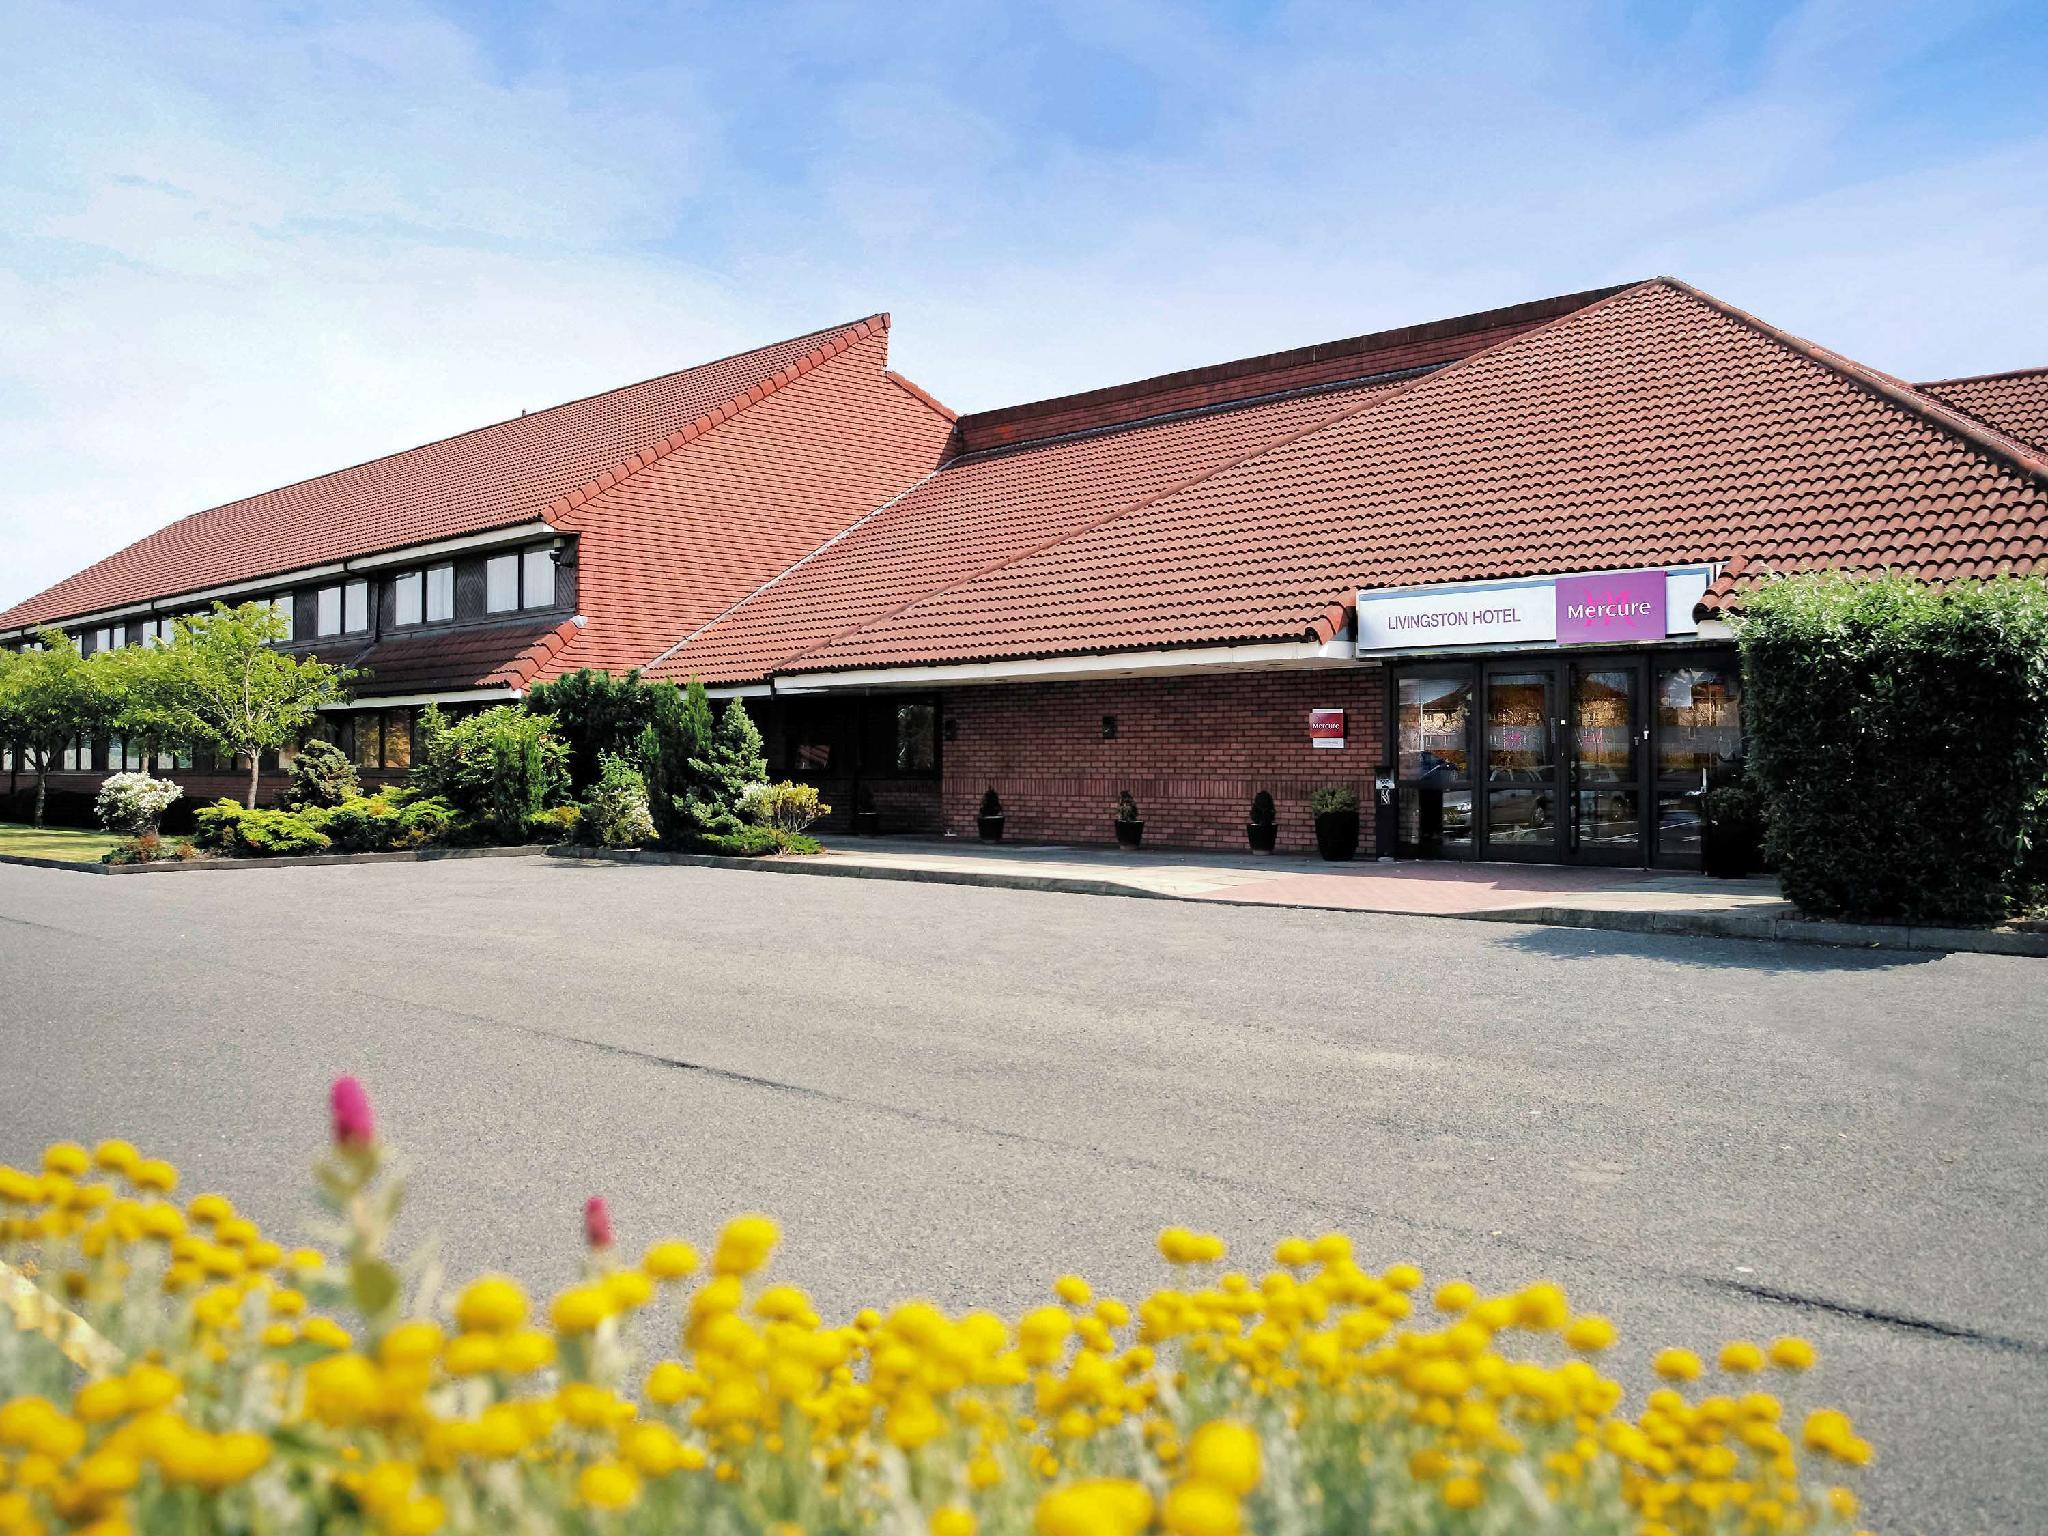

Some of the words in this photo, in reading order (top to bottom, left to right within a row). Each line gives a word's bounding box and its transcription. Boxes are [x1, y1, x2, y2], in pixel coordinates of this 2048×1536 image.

[1388, 611, 1468, 630] LIVINGSTON
[1472, 608, 1521, 625] HOTEL
[1567, 602, 1652, 619] Mercure
